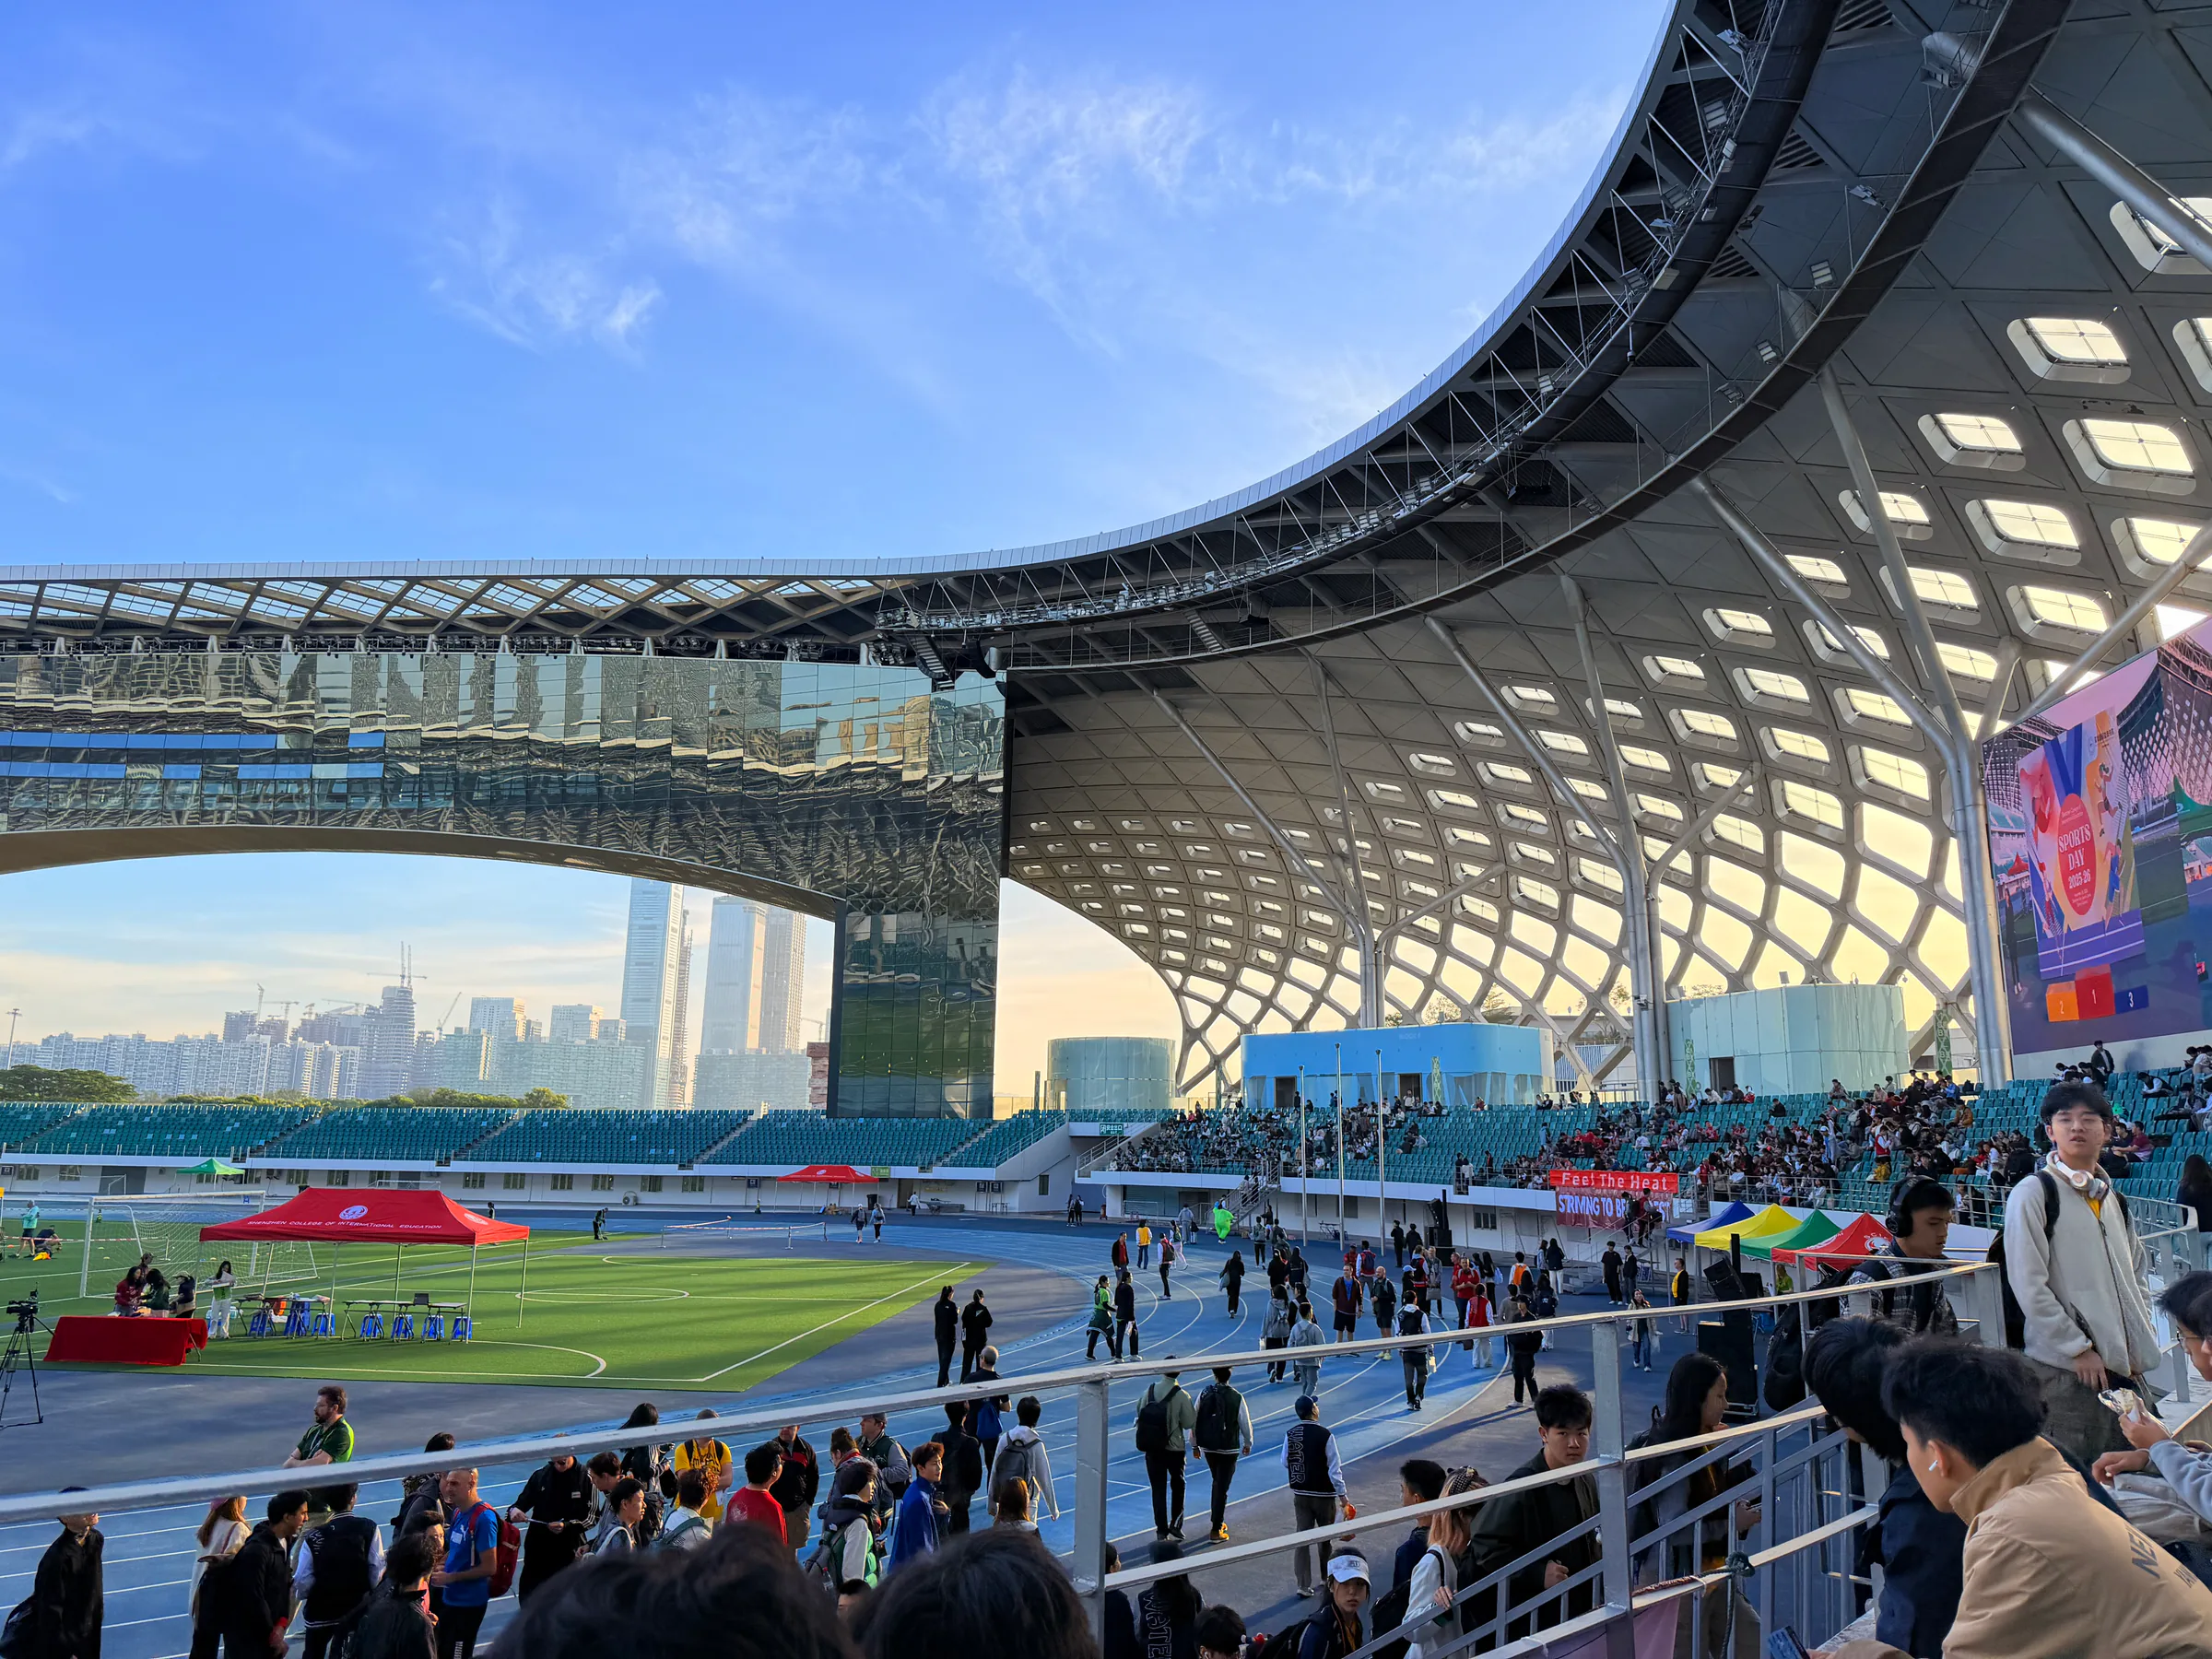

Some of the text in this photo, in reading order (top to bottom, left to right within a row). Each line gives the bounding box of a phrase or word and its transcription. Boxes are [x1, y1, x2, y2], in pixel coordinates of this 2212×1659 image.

[2058, 824, 2090, 853] SPORTS
[2067, 847, 2085, 872] DAY
[2059, 1000, 2065, 1015] 2
[2091, 988, 2097, 1005] 1
[2127, 991, 2135, 1008] 3
[1561, 1172, 1667, 1191] Feel The Heat
[1559, 1194, 1600, 1216] STRIVING
[1601, 1197, 1614, 1217] TO
[1288, 1426, 1306, 1484] WATER
[1143, 1592, 1172, 1659] WATE
